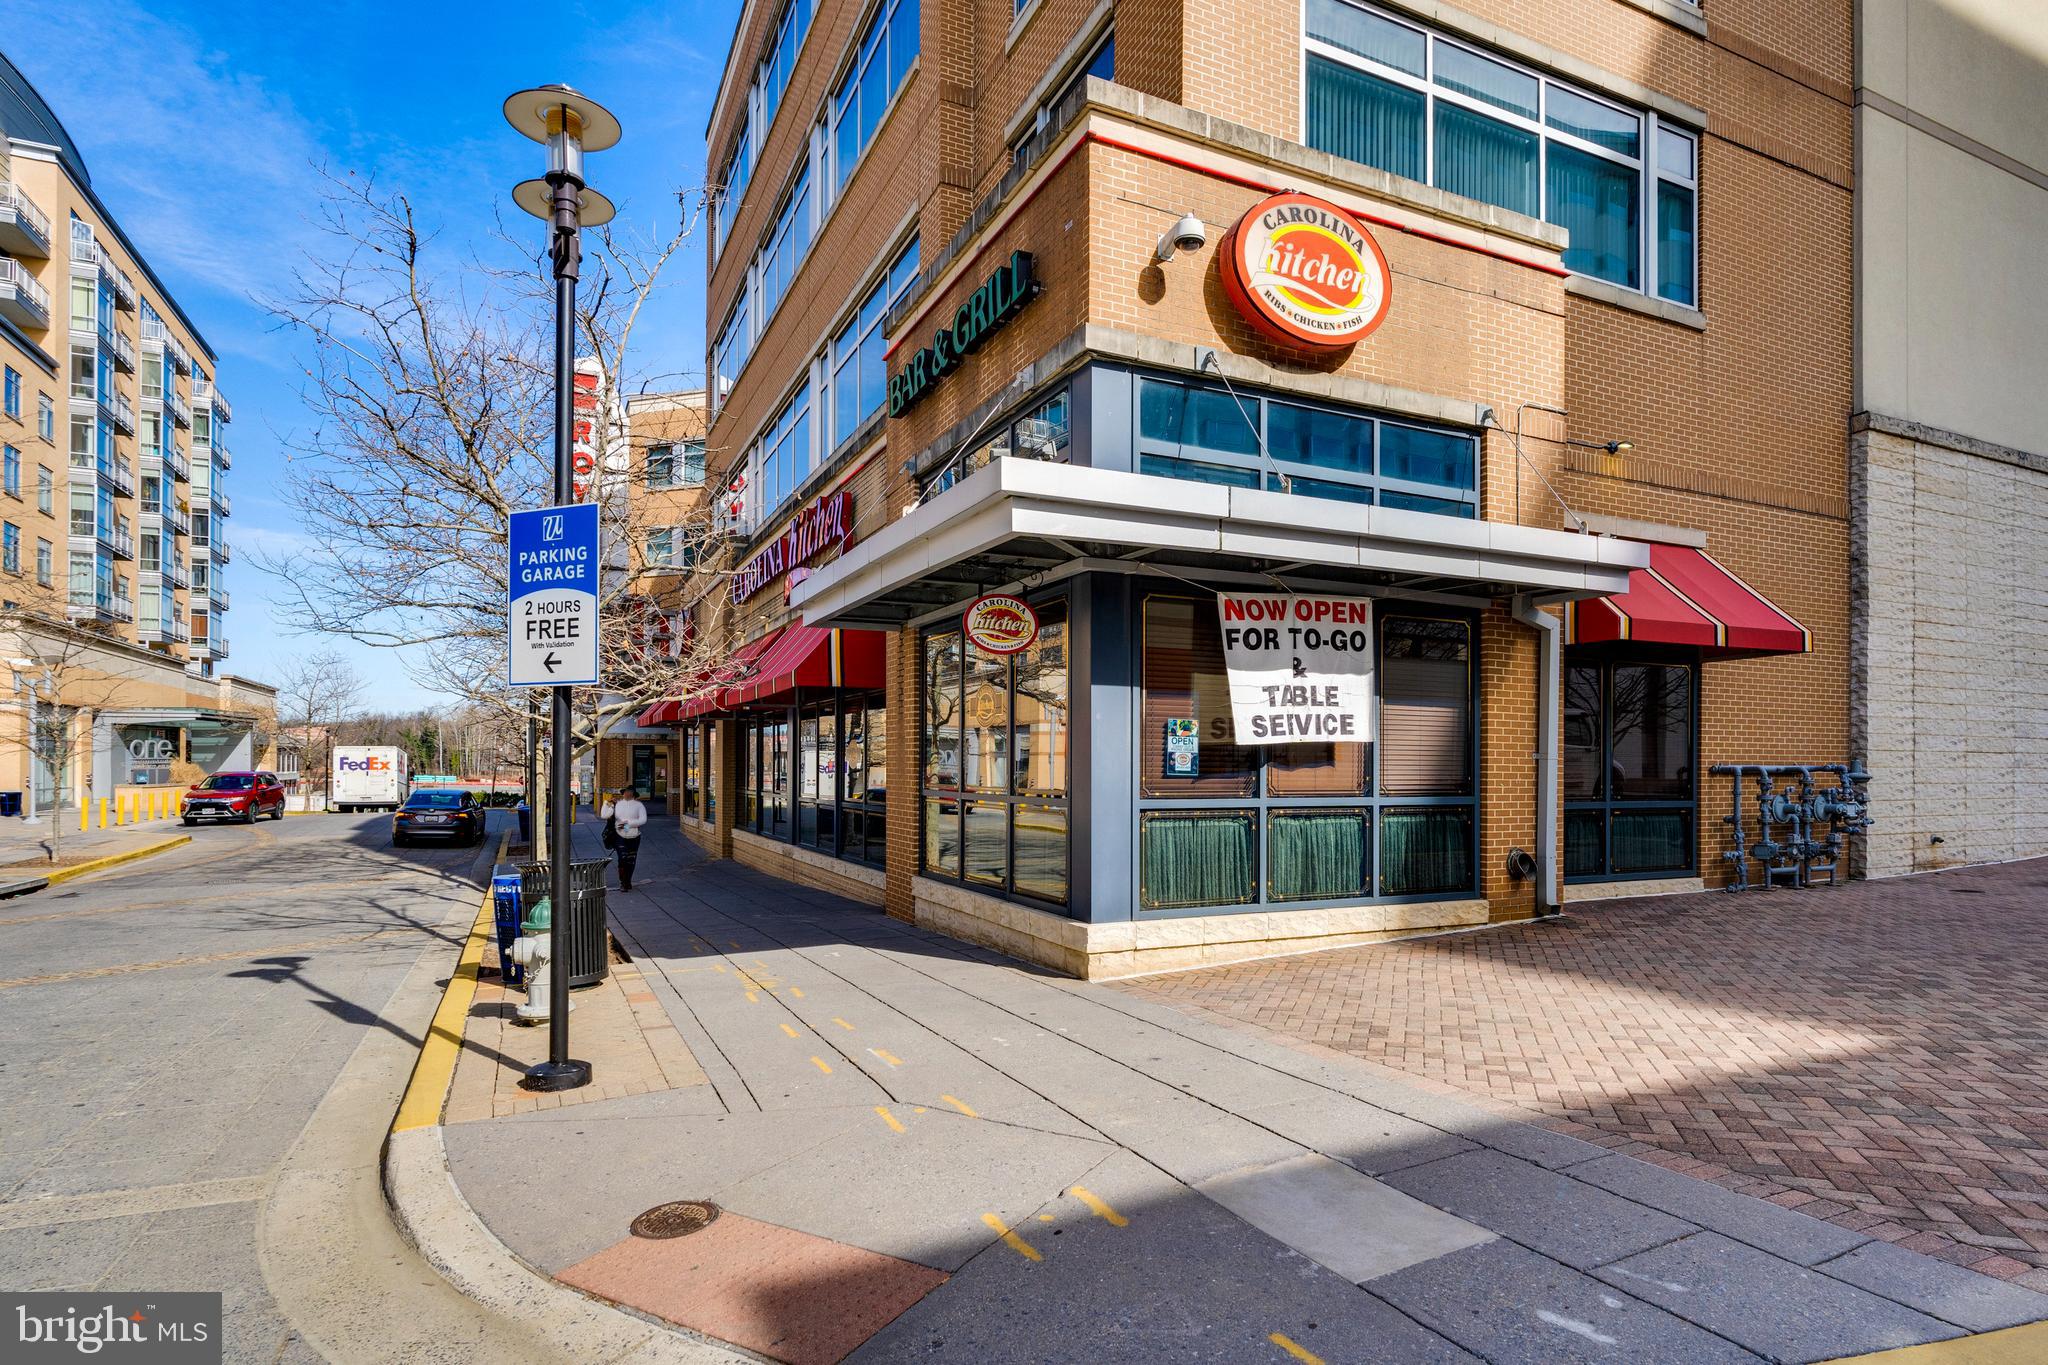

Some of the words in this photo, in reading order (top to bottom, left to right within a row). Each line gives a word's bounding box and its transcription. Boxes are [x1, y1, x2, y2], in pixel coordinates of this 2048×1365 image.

[1263, 207, 1365, 256] CAROLINA
[1264, 289, 1287, 313] RIBS
[1294, 312, 1336, 330] CHICKEN
[1342, 315, 1363, 329] FISH
[889, 348, 926, 418] BAR
[932, 329, 948, 376] &
[953, 250, 1028, 354] GRILL
[519, 546, 588, 566] PARKING
[521, 564, 585, 583] GARAGE
[732, 538, 784, 605] CAROLINA
[525, 601, 533, 616] 2
[537, 600, 581, 615] HOURS
[976, 598, 1027, 615] CAROLINA
[1224, 599, 1287, 621] NOW
[1294, 600, 1366, 624] OPEN
[526, 617, 580, 641] FREE
[1225, 628, 1280, 651] FOR
[1288, 628, 1367, 652] TO-GO
[531, 642, 545, 650] With
[545, 640, 575, 649] Validation
[1292, 657, 1308, 679] &
[1262, 685, 1339, 707] TABLE
[129, 739, 175, 758] one
[1171, 737, 1194, 746] OPEN
[339, 756, 391, 771] FedEx
